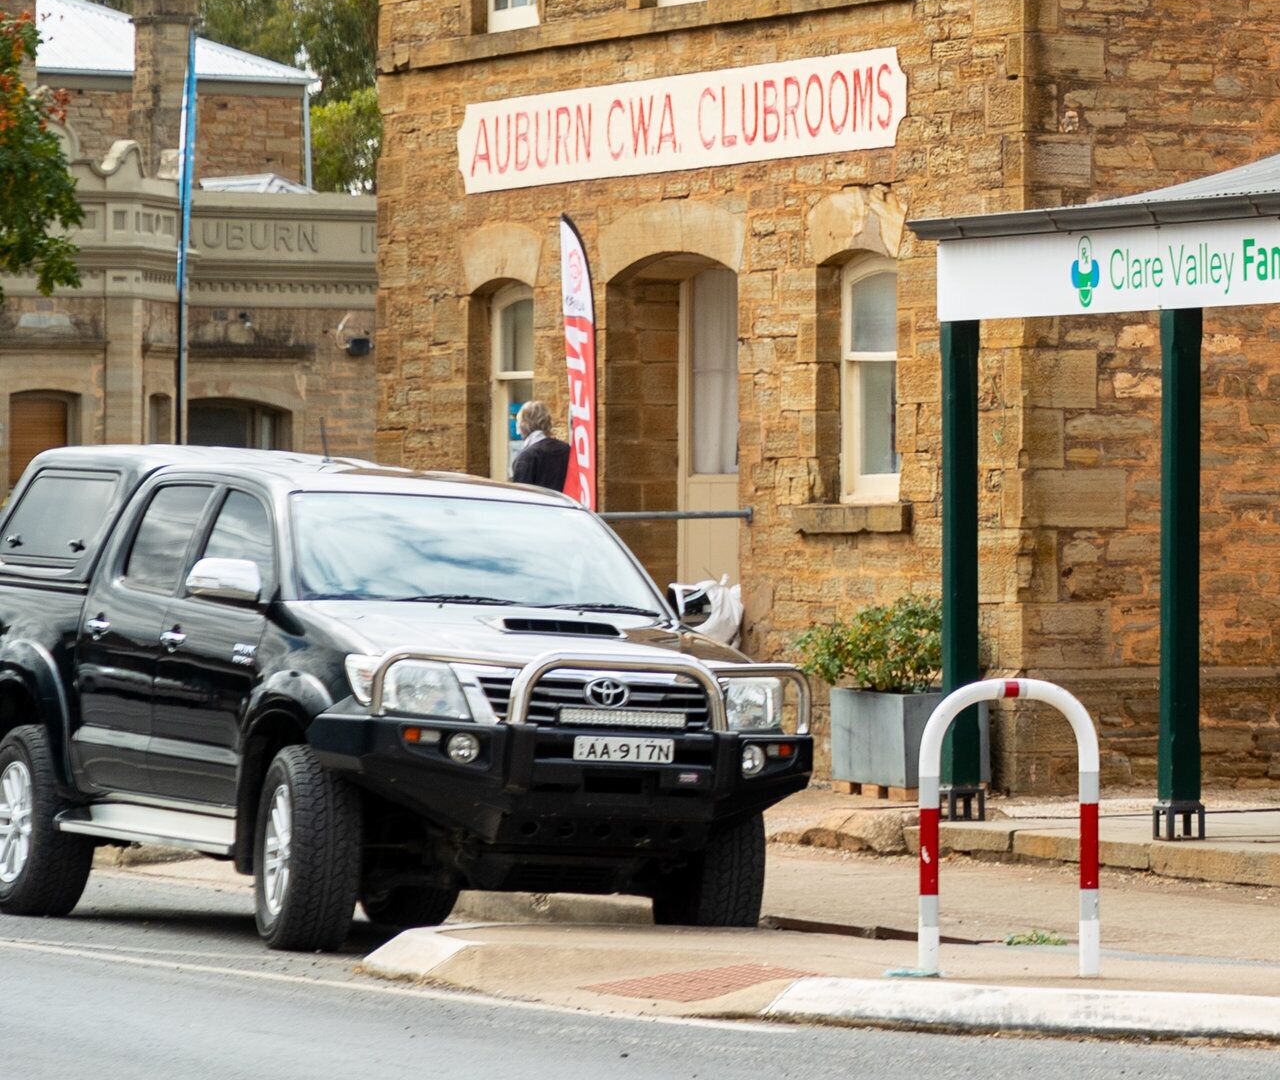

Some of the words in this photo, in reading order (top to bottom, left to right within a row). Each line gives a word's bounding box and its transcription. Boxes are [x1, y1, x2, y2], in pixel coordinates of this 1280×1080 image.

[470, 103, 593, 178] AUBURN
[698, 63, 894, 151] CLUBROOMS
[1109, 248, 1164, 291] Clare
[1169, 242, 1235, 295] Valley
